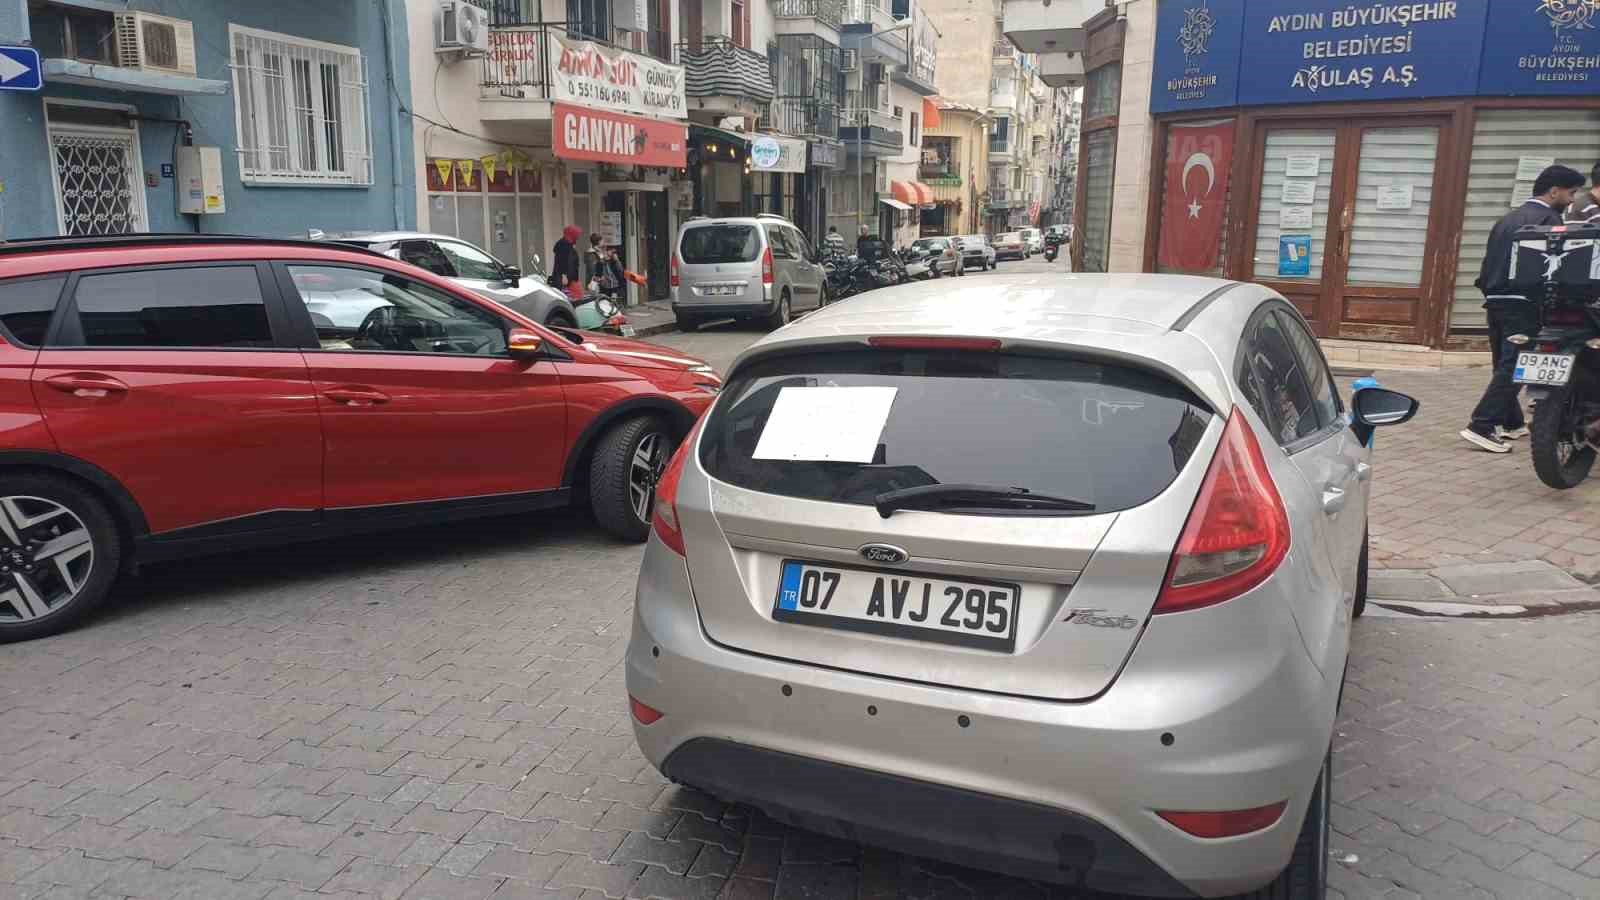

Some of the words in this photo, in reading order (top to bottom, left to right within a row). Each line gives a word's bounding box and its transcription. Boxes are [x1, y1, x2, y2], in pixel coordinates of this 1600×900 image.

[1268, 13, 1323, 32] AYDIN
[1331, 0, 1457, 28] BÜYÜKŞEHİR
[1303, 31, 1413, 59] BELEDİYESİ
[1519, 54, 1600, 72] BÜYÜKŞEHİ
[1382, 65, 1418, 88] A.Ş.
[564, 113, 637, 156] GANYAN
[1519, 354, 1538, 366] 09
[1537, 369, 1566, 381] 087
[867, 547, 898, 561] Ford
[783, 590, 798, 600] TR
[800, 570, 841, 611] 07
[866, 577, 932, 623] AVJ
[940, 586, 1009, 633] 295
